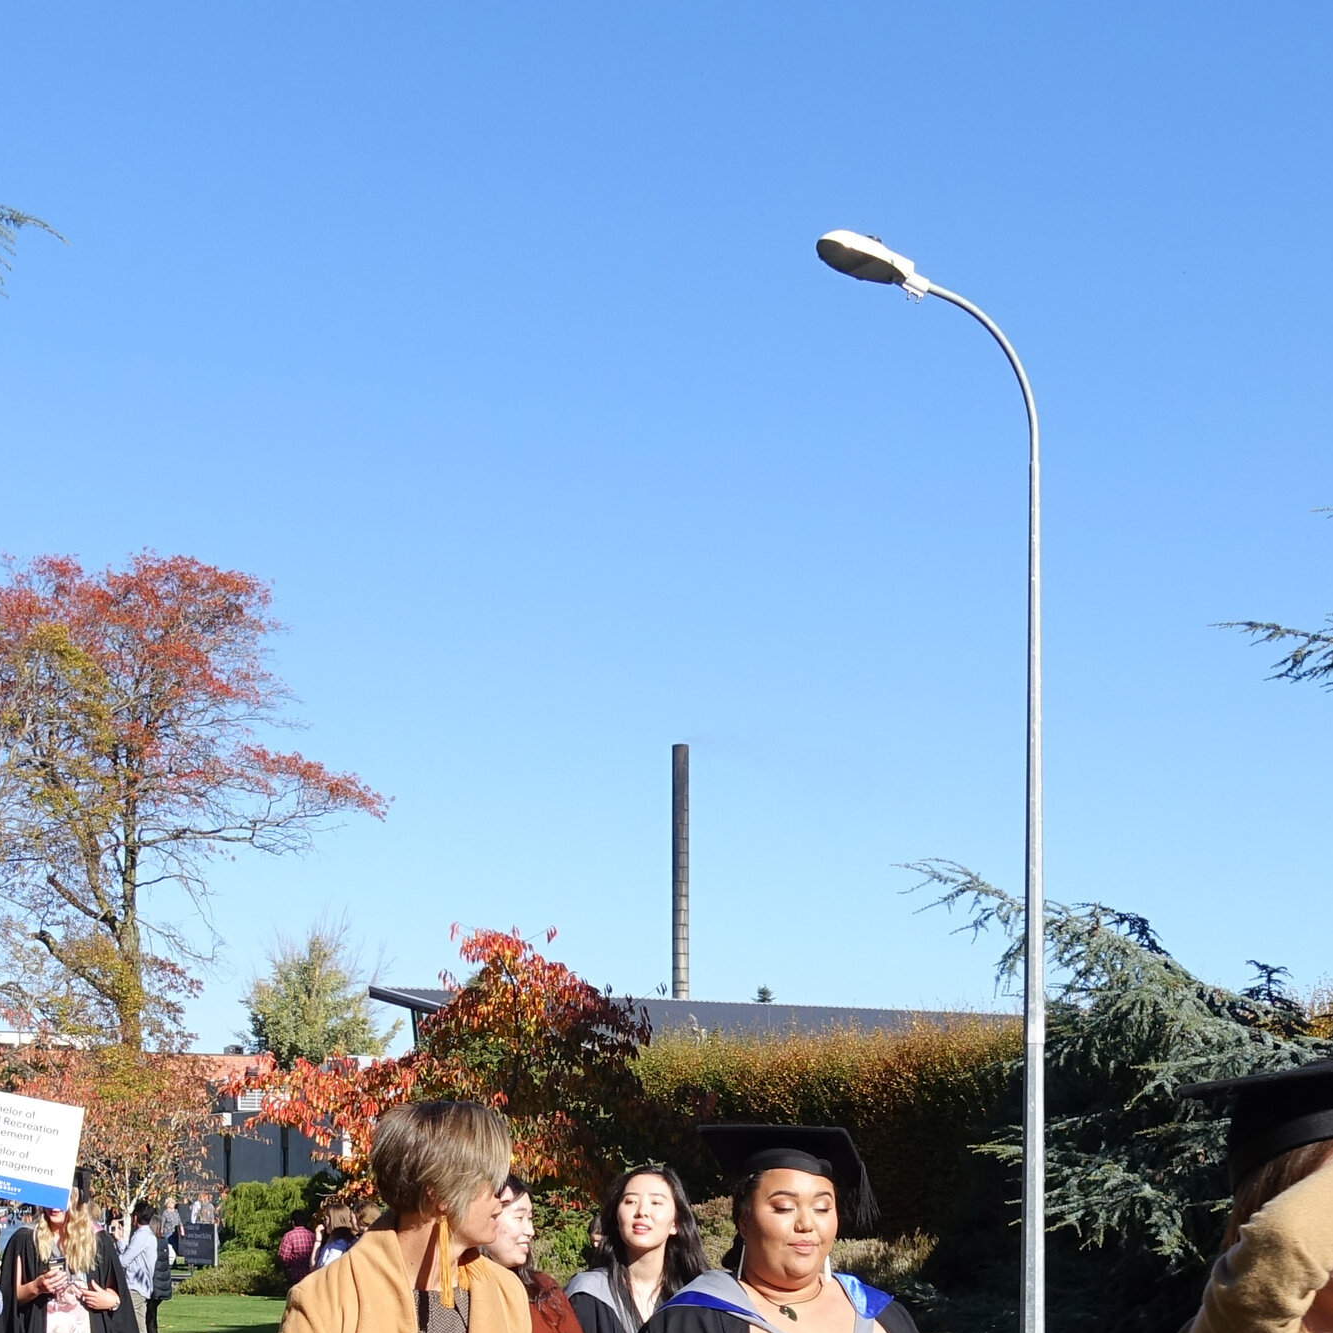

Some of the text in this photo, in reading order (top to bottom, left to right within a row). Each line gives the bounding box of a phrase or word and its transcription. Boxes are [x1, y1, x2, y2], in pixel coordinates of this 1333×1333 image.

[25, 1111, 36, 1120] of
[3, 1117, 60, 1136] Recreation
[19, 1151, 30, 1160] of
